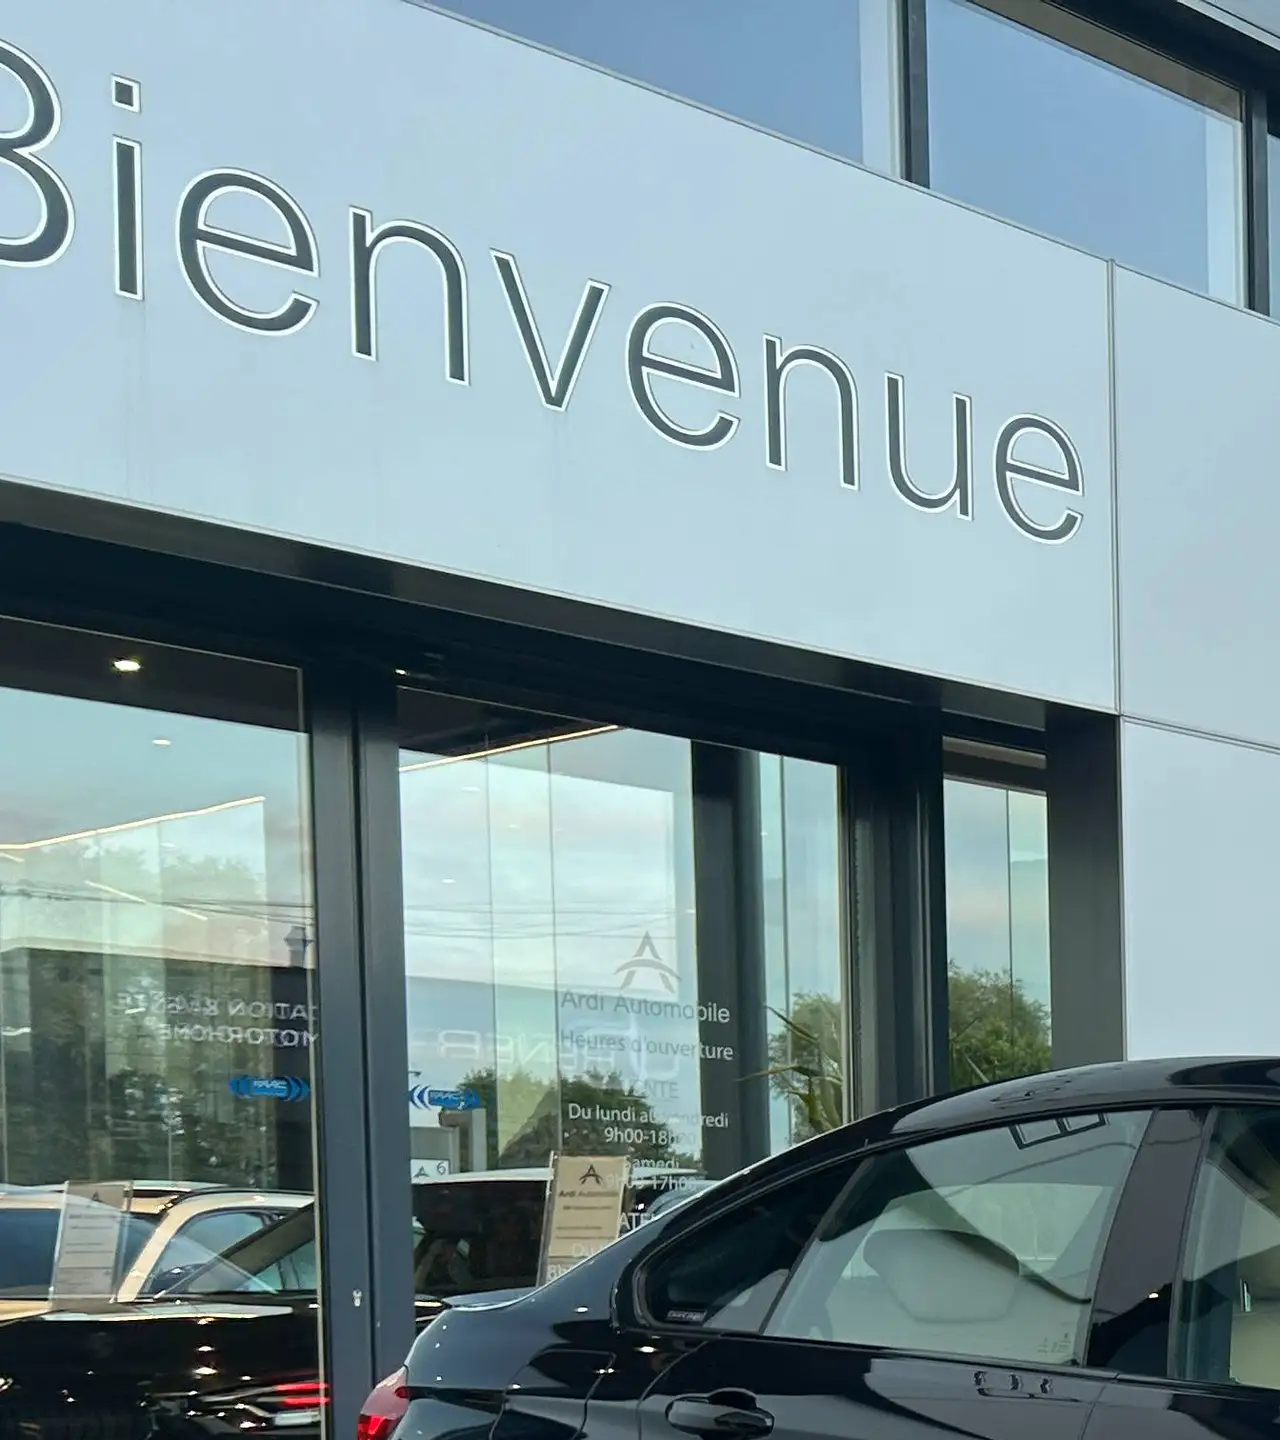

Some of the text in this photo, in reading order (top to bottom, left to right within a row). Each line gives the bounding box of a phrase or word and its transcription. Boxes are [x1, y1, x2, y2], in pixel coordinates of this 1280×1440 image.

[560, 989, 731, 1023] Ardi Automobile
[560, 1028, 626, 1050] Heures
[631, 1036, 734, 1061] d'ouverture
[568, 1103, 592, 1120] Du
[596, 1105, 636, 1122] lundi
[604, 1127, 697, 1146] 9h00-18h
